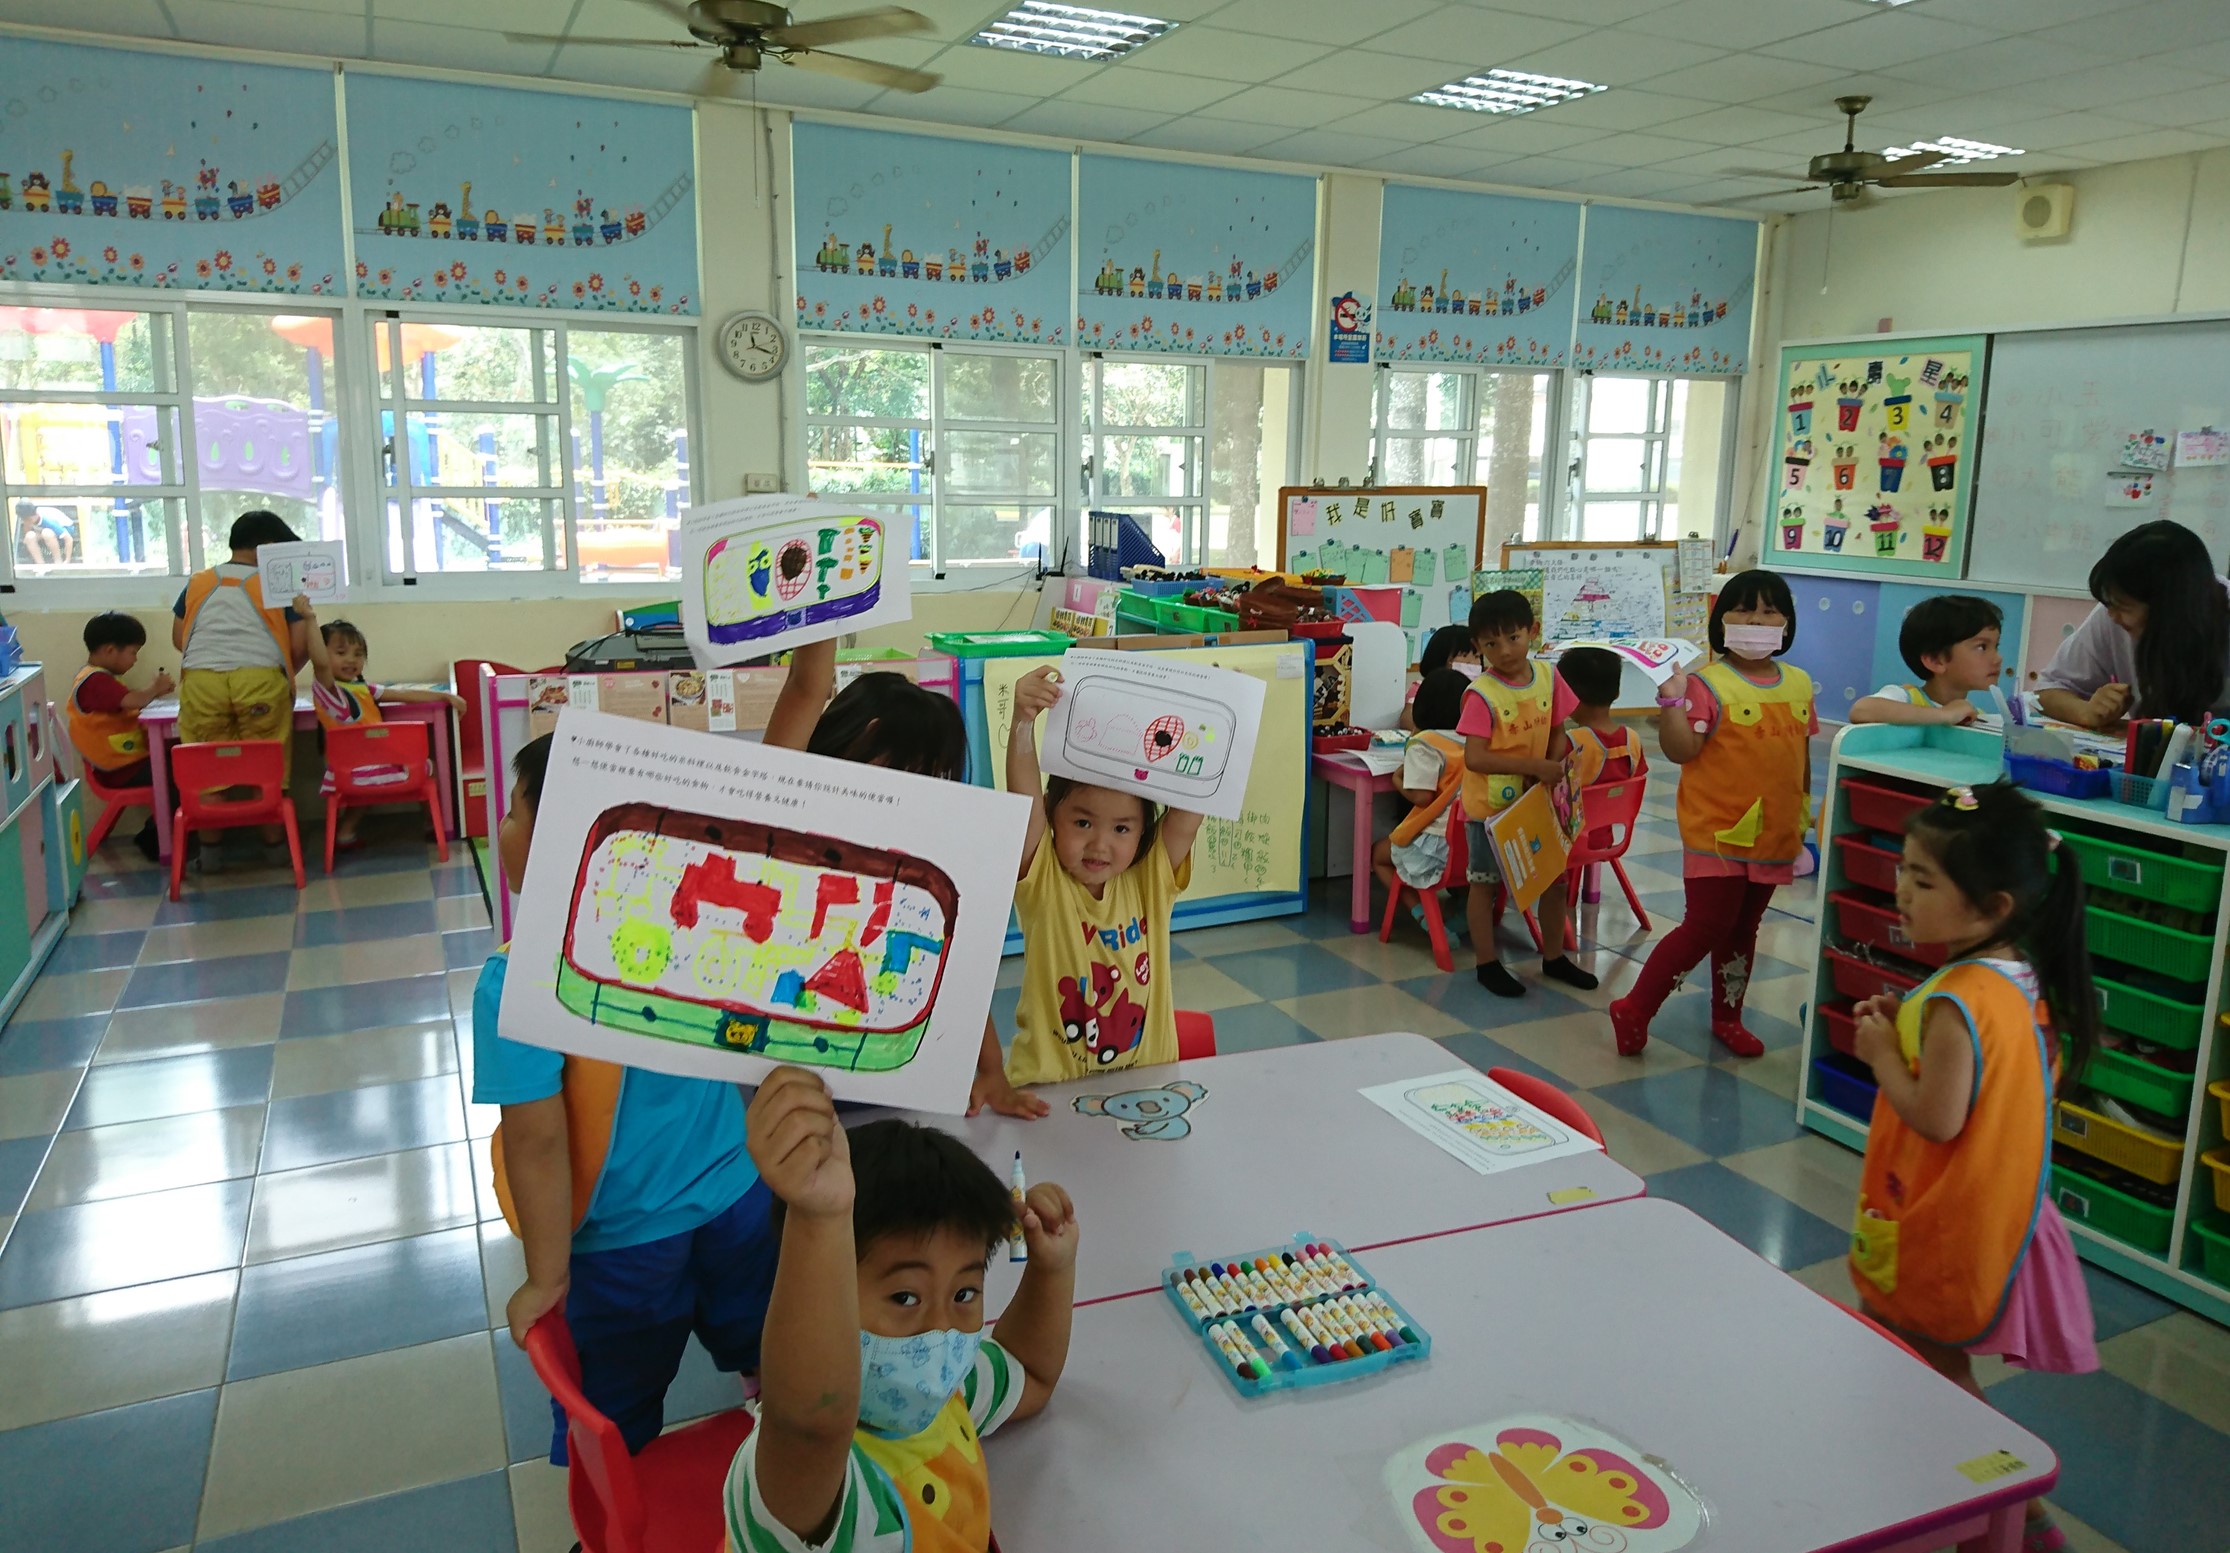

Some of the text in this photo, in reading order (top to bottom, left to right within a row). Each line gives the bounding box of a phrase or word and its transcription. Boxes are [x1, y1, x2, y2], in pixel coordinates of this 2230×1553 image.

[1796, 413, 1806, 432] 1
[1841, 408, 1854, 427] 2
[1892, 406, 1904, 425] 3
[1939, 404, 1953, 424] 4
[1789, 468, 1800, 485] 5
[1838, 467, 1849, 485] 6
[1885, 469, 1898, 488] 7
[1936, 466, 1949, 486] 8
[1325, 496, 1445, 530] 我是好寶寶
[1786, 528, 1797, 545] 9
[1824, 529, 1843, 547] 10
[1877, 532, 1896, 552] 11
[1923, 538, 1945, 559] 12
